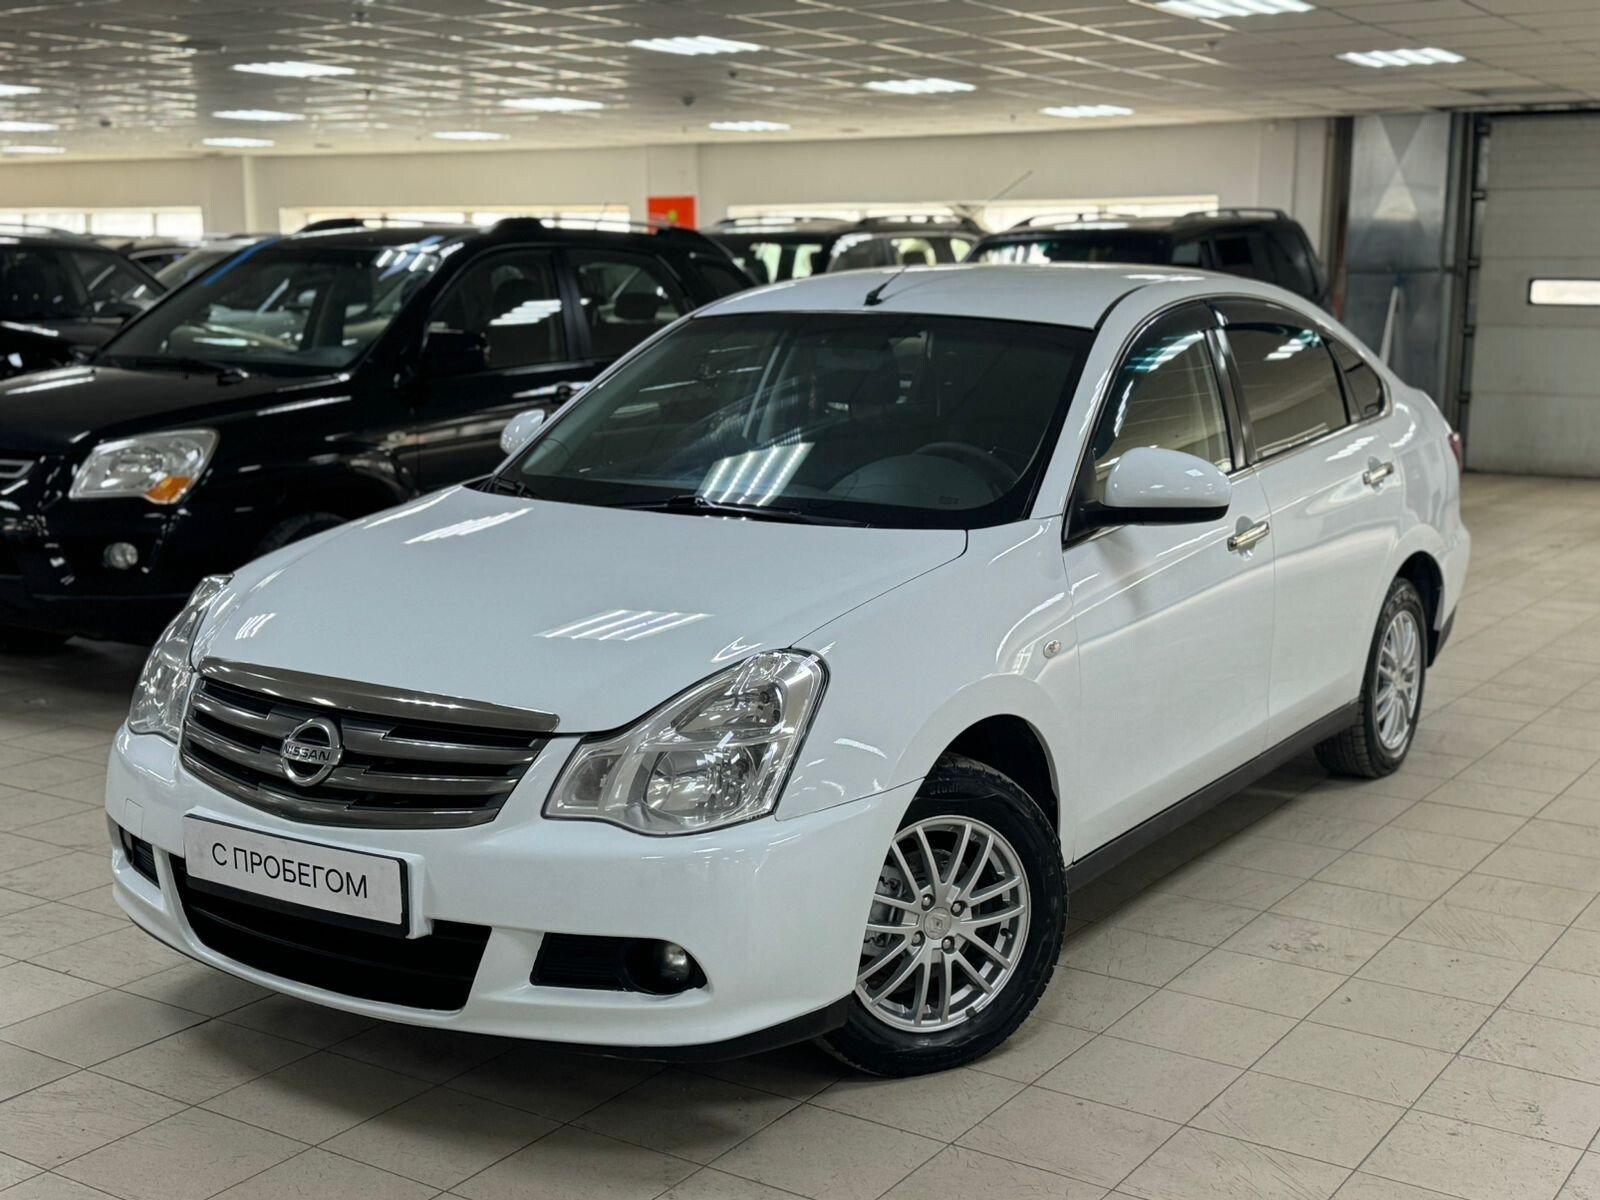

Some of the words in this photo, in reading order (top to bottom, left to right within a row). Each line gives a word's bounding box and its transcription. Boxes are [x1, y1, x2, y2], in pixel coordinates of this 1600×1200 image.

[284, 743, 331, 761] NISSAN
[212, 842, 228, 866] С
[233, 847, 368, 899] ПРОБЕГОМ
